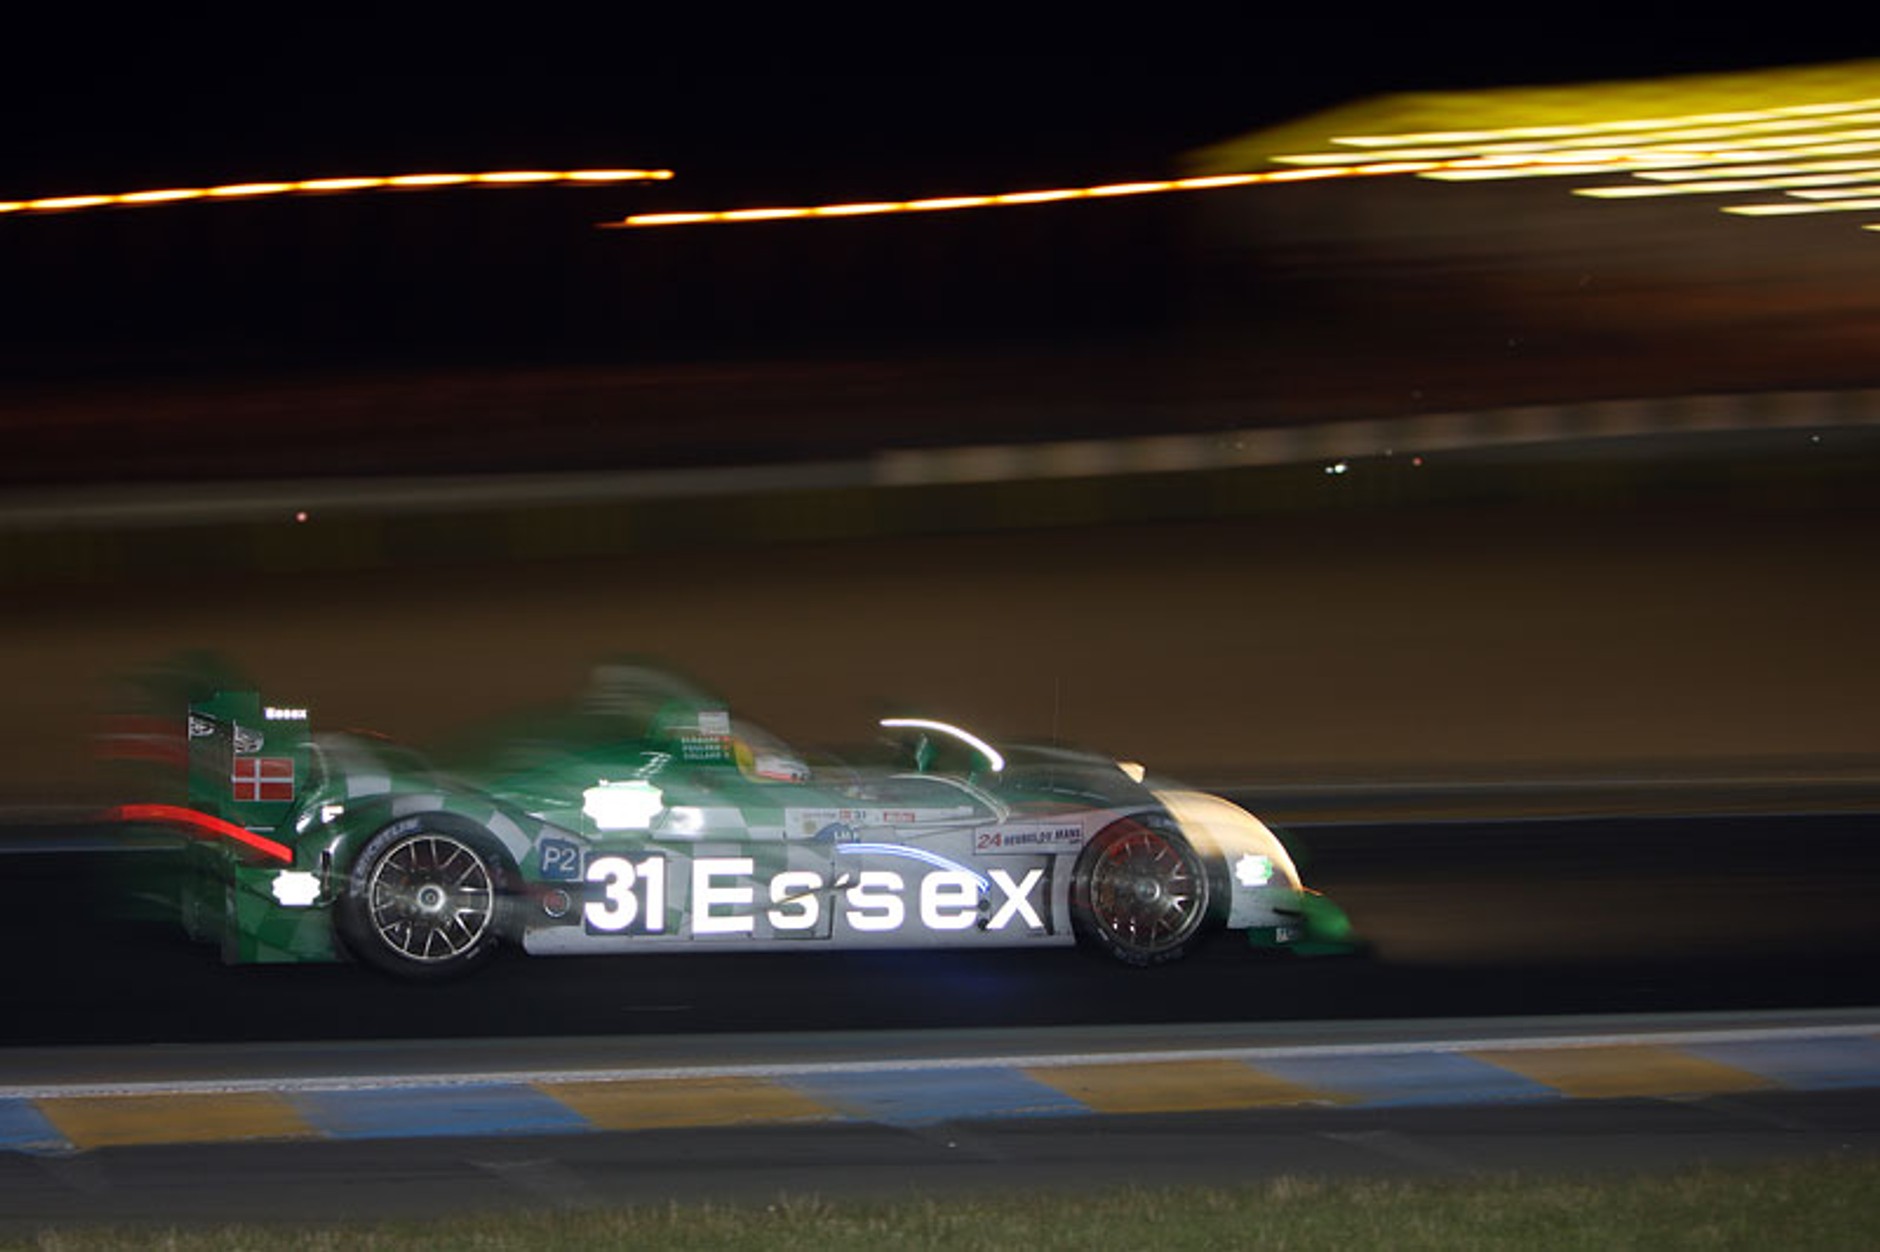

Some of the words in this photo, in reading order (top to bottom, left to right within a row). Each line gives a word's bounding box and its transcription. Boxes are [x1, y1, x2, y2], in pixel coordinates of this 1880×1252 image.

[542, 846, 577, 872] P2
[977, 832, 1002, 849] 24
[584, 856, 665, 931] 31
[692, 857, 1044, 934] Essex
